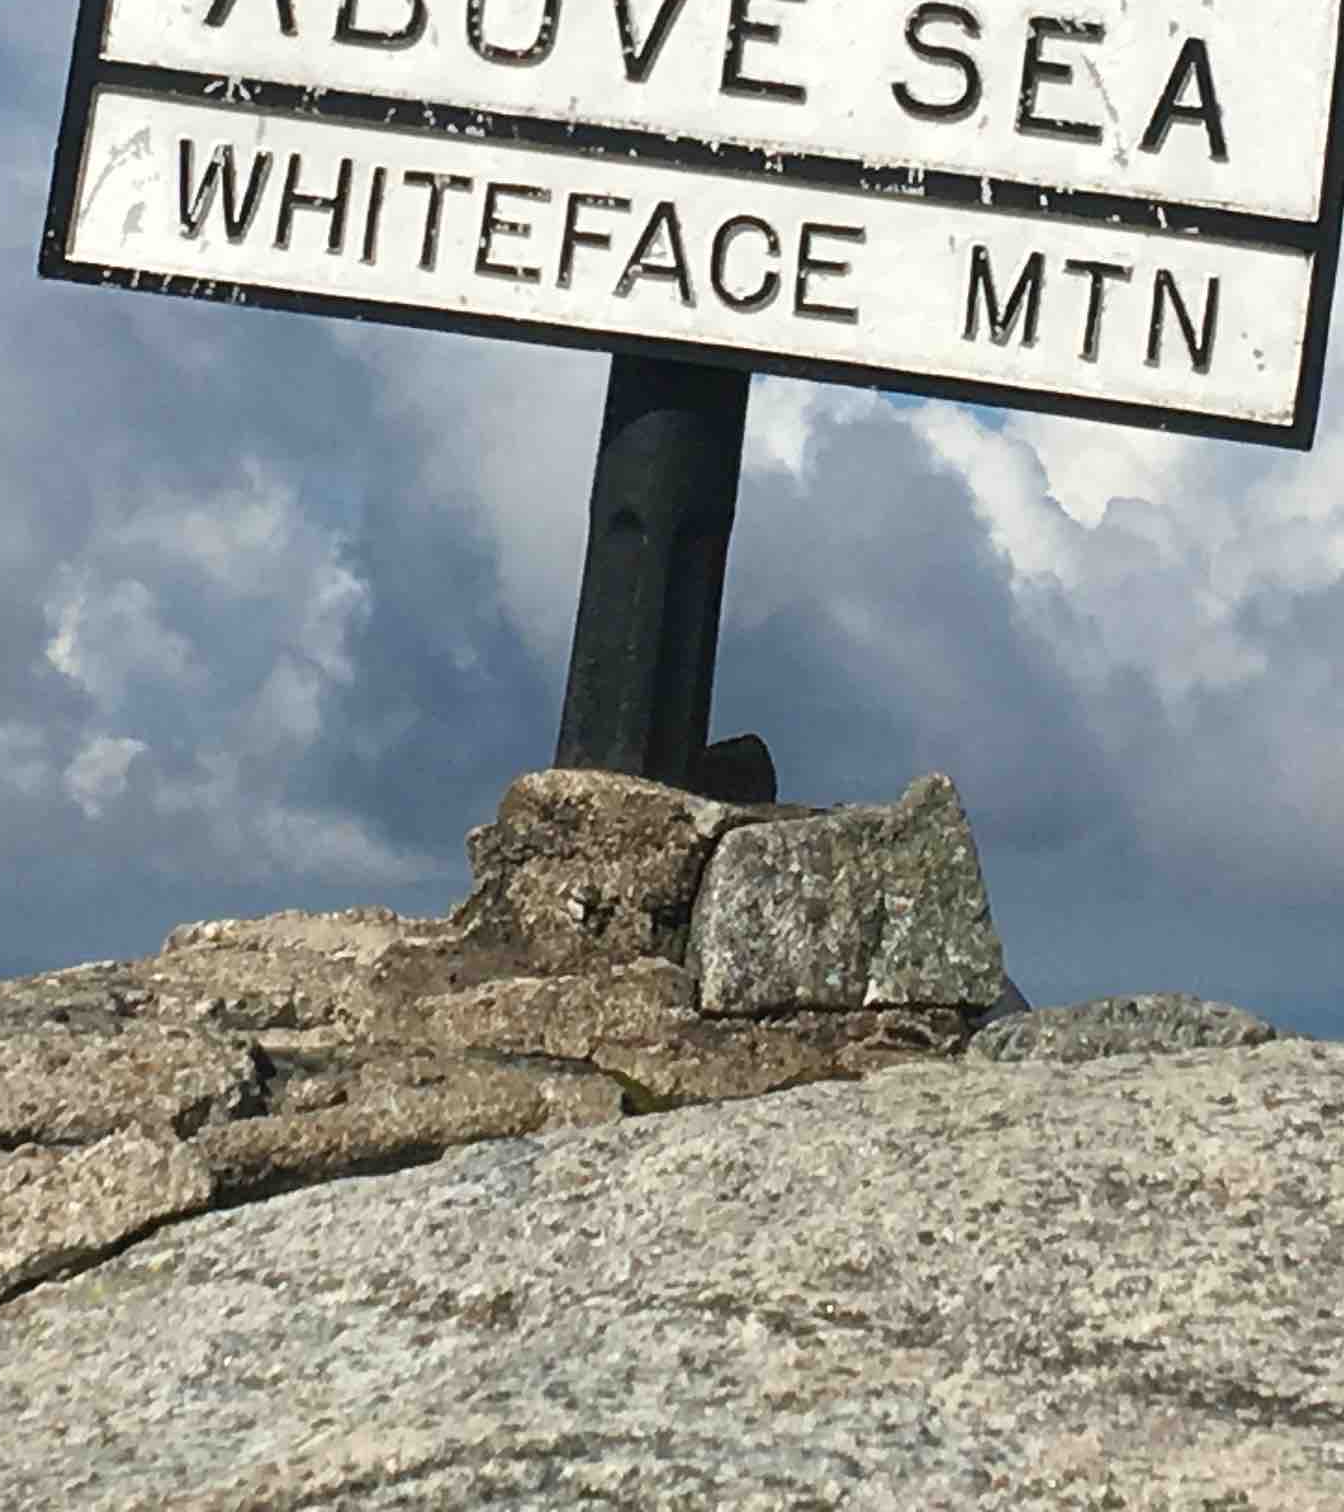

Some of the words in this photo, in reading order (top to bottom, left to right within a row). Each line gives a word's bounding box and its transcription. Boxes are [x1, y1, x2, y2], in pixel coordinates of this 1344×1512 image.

[890, 1, 1229, 163] SEA
[176, 138, 866, 321] WHITEFACE
[962, 244, 1220, 375] MTN
